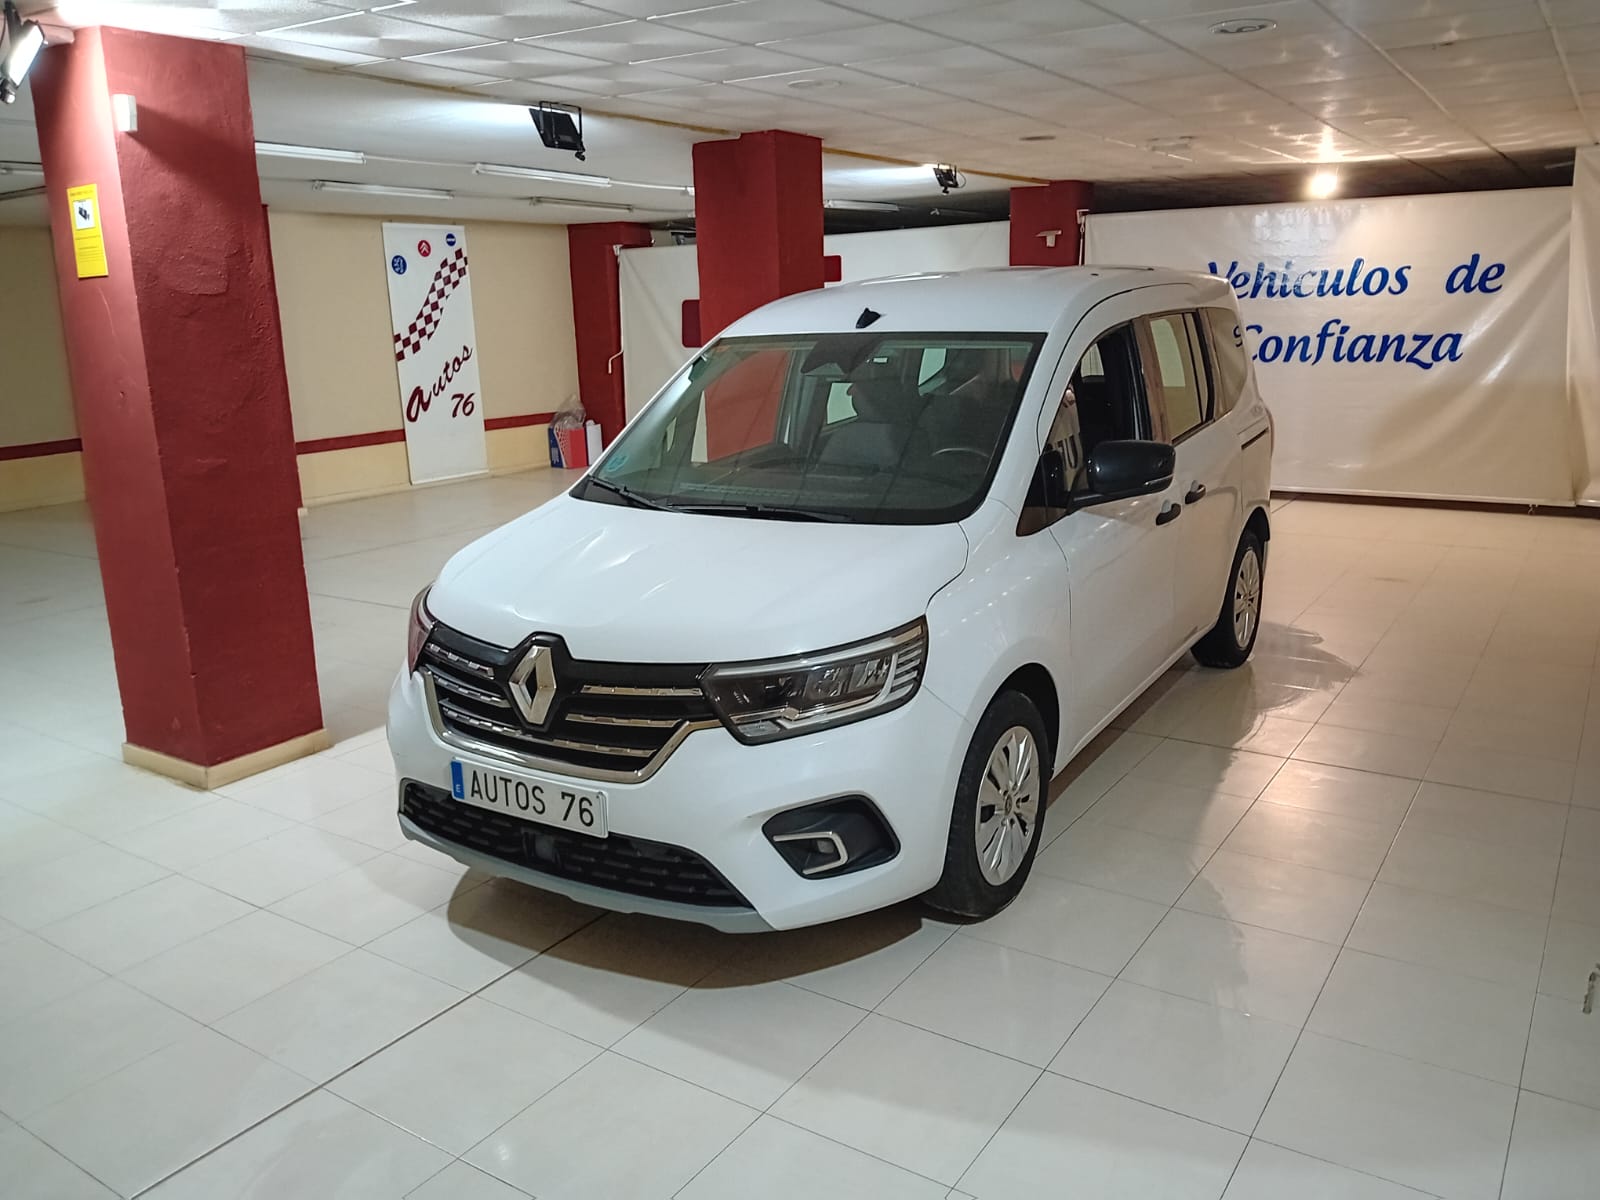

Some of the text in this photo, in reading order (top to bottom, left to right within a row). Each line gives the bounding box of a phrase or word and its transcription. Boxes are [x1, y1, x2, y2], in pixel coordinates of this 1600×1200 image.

[1445, 253, 1505, 294] de
[451, 392, 475, 418] 76
[455, 783, 461, 793] E
[470, 769, 594, 827] AUTOS 76
